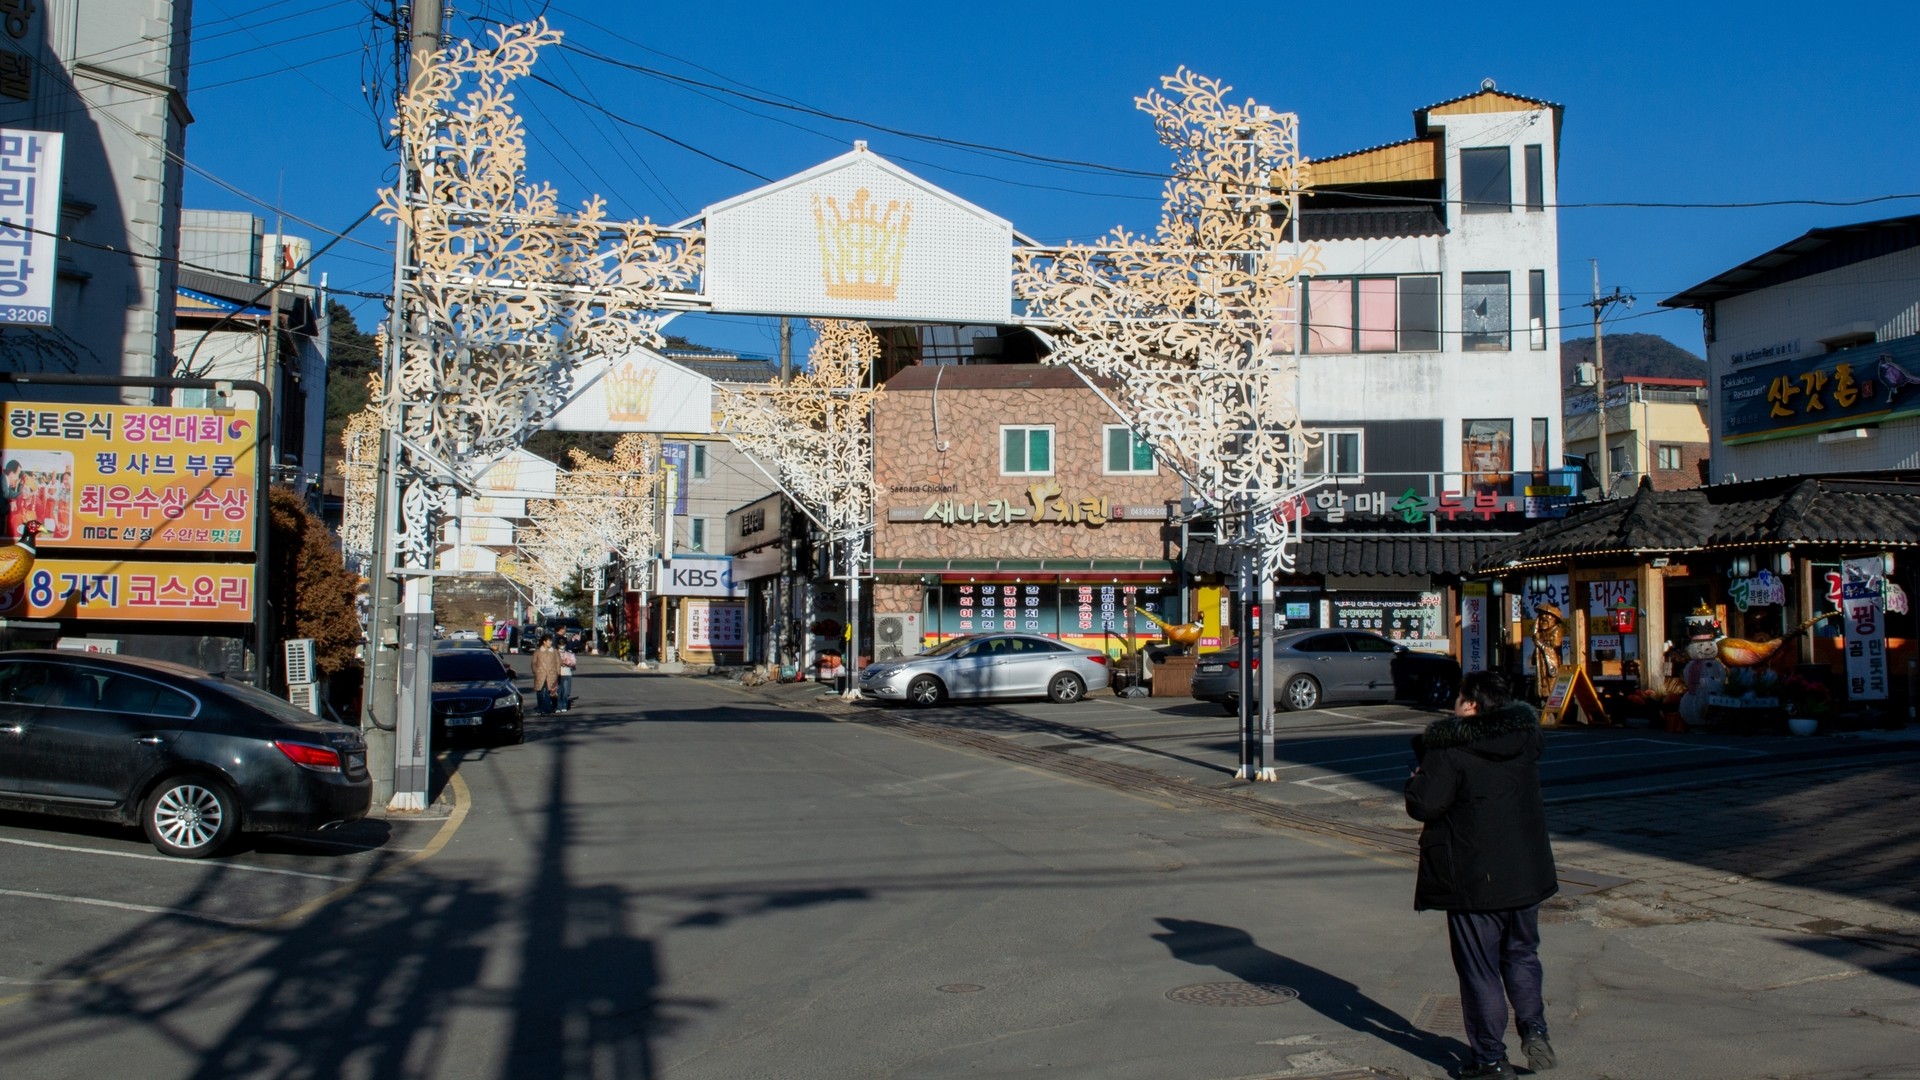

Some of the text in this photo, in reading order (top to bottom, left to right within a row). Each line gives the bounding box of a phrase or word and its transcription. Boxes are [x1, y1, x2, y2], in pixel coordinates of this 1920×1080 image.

[10, 409, 223, 443] 향토음식 경연대회
[125, 453, 176, 475] 샤브
[185, 455, 235, 477] 부문
[79, 485, 248, 520] 최우수상 수상
[890, 485, 920, 493] Saenara
[924, 496, 1108, 525] 새나라 치킨
[83, 526, 118, 539] MBC
[122, 527, 153, 541] 선정
[672, 568, 718, 587] KBS
[128, 575, 248, 610] 코스요리
[981, 585, 996, 630] 양념치킨
[1852, 605, 1876, 635] 꿩
